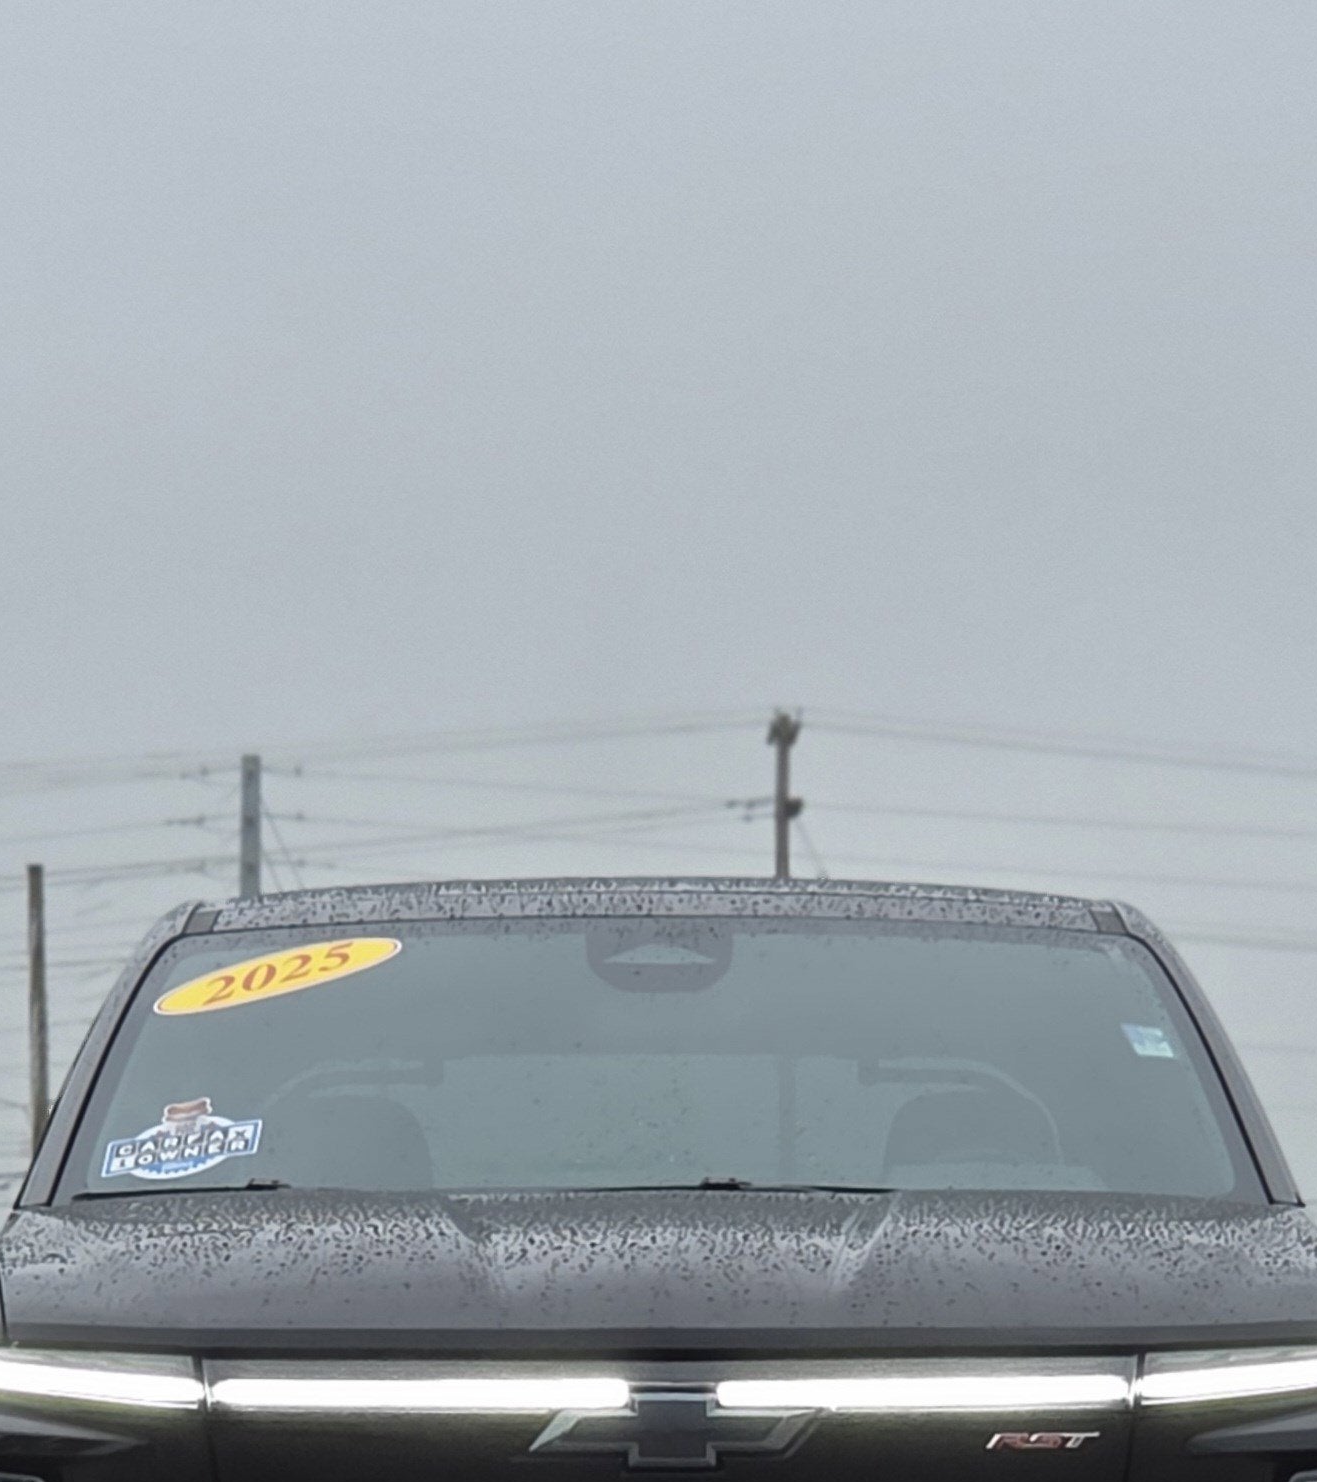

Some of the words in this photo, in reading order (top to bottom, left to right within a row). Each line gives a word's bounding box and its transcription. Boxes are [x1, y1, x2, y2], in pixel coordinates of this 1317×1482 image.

[203, 941, 356, 1006] 2025
[117, 1129, 249, 1157] CARFAX
[985, 1431, 1101, 1450] RST
